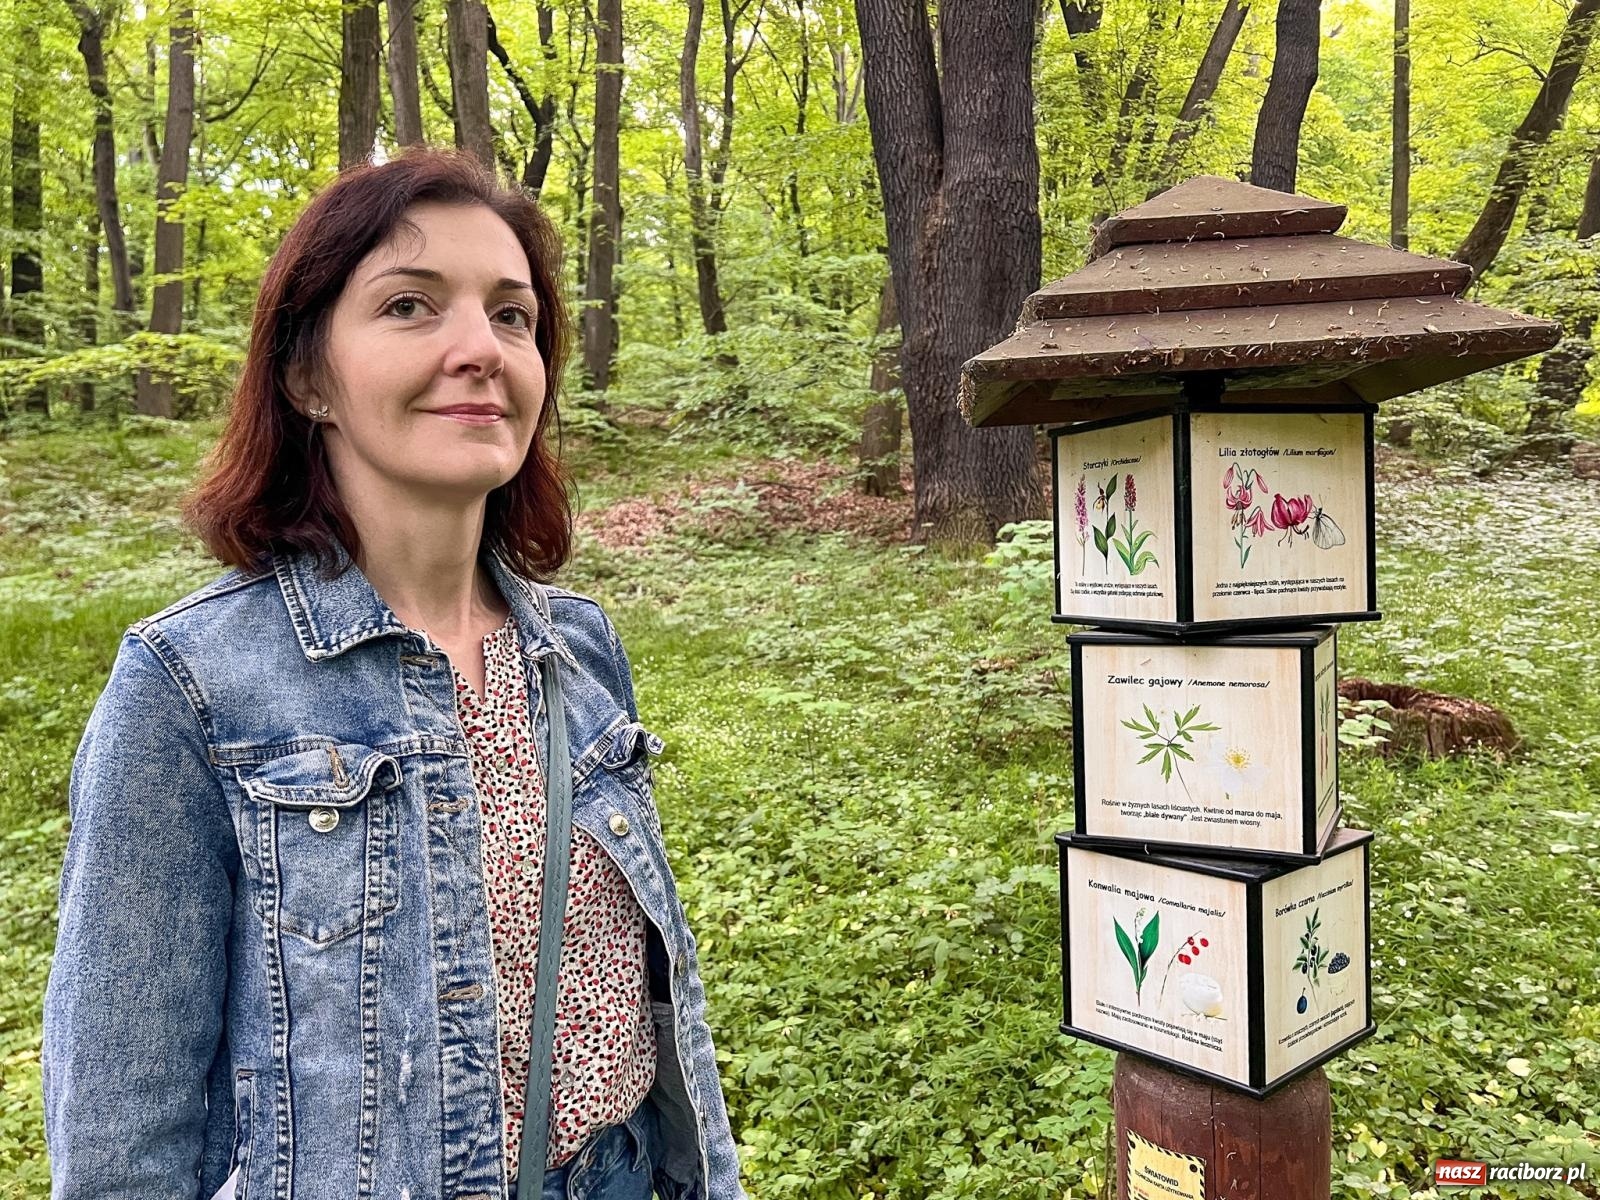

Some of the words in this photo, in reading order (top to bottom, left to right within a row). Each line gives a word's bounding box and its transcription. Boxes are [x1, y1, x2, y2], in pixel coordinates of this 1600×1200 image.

[1218, 447, 1237, 457] Lilia
[1240, 446, 1280, 459] złotogłów
[1283, 447, 1303, 457] /Lilium
[1107, 675, 1145, 685] Zawilec
[1148, 676, 1184, 689] gajowy
[1187, 678, 1226, 687] /Anemone
[1229, 681, 1271, 689] nemorosa/
[1121, 810, 1142, 818] tworząc
[1204, 816, 1239, 824] zwiastunem
[1240, 819, 1262, 828] wiosny.
[1128, 801, 1150, 809] żyznych
[1265, 812, 1283, 820] maja,
[1088, 879, 1122, 894] Konwalia
[1124, 888, 1155, 901] majowa
[1158, 897, 1196, 912] /Convallaria
[1198, 907, 1226, 918] majalis/
[1275, 903, 1297, 918] Borówka
[1298, 896, 1315, 908] czarna
[1182, 1033, 1199, 1044] Roślina
